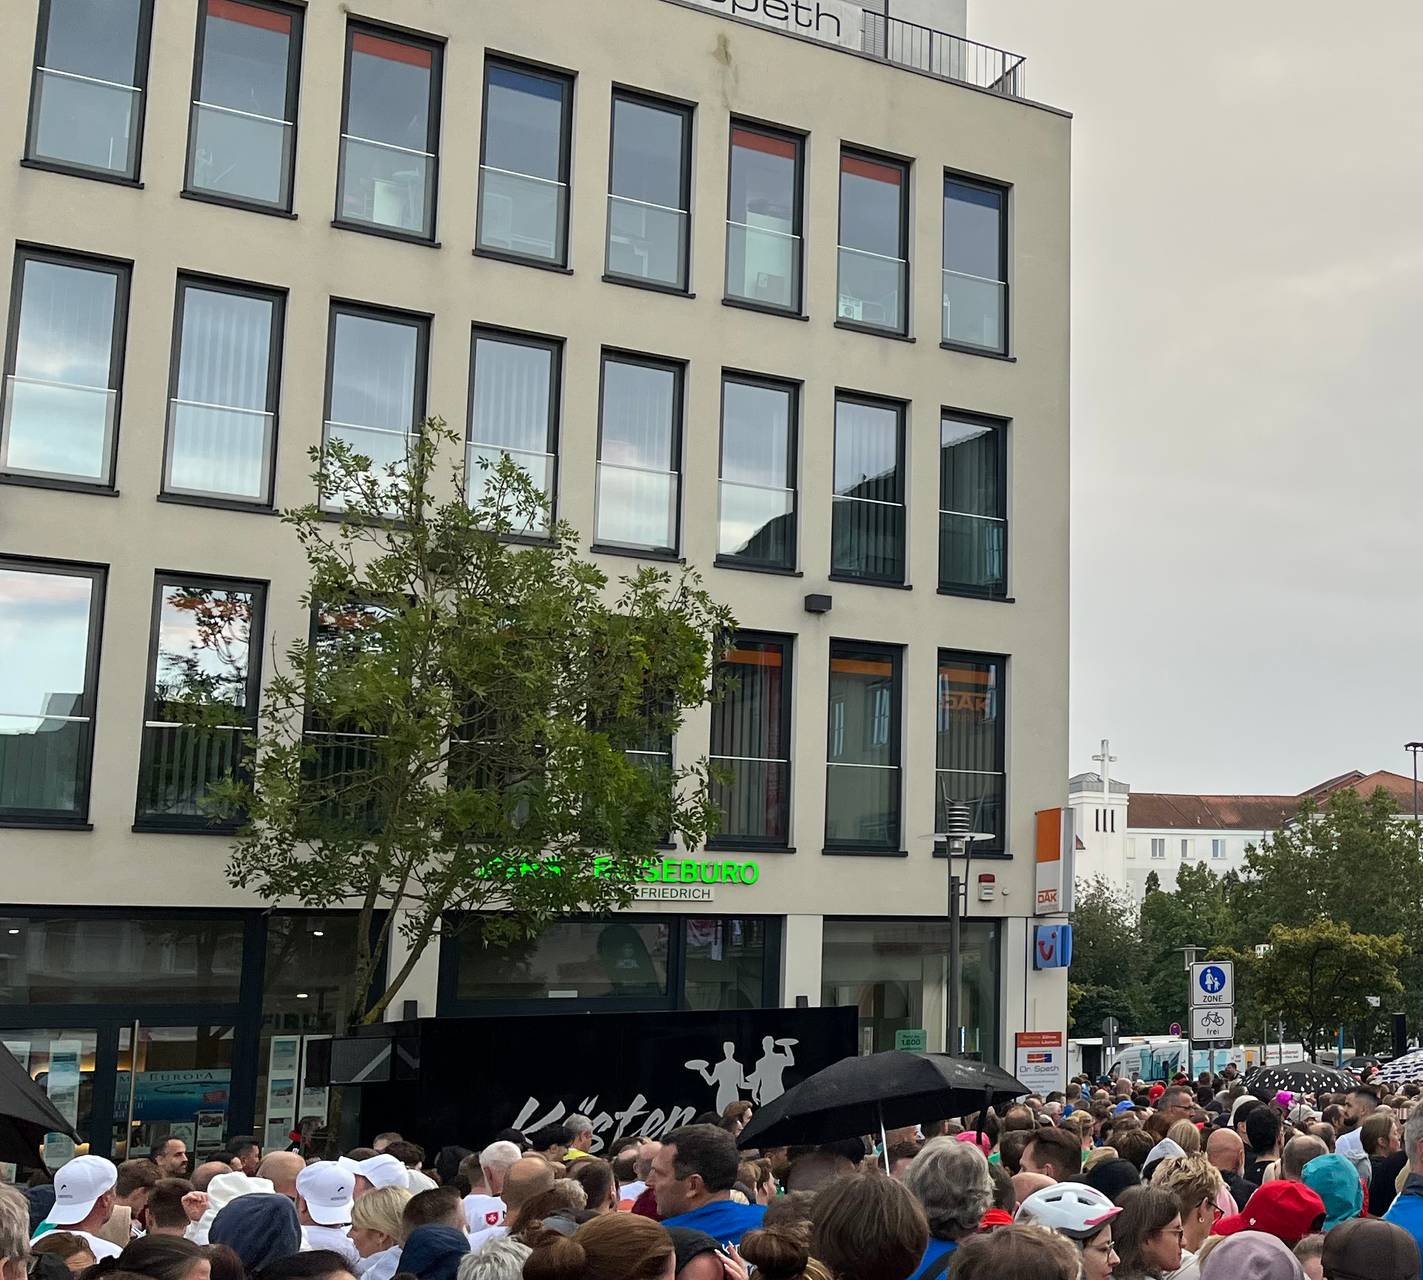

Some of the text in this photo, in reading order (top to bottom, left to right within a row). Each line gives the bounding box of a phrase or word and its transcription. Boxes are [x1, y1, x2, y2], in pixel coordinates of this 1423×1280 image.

[706, 0, 840, 37] peth
[641, 887, 711, 899] FRIEDRICH
[1038, 889, 1057, 903] DAK
